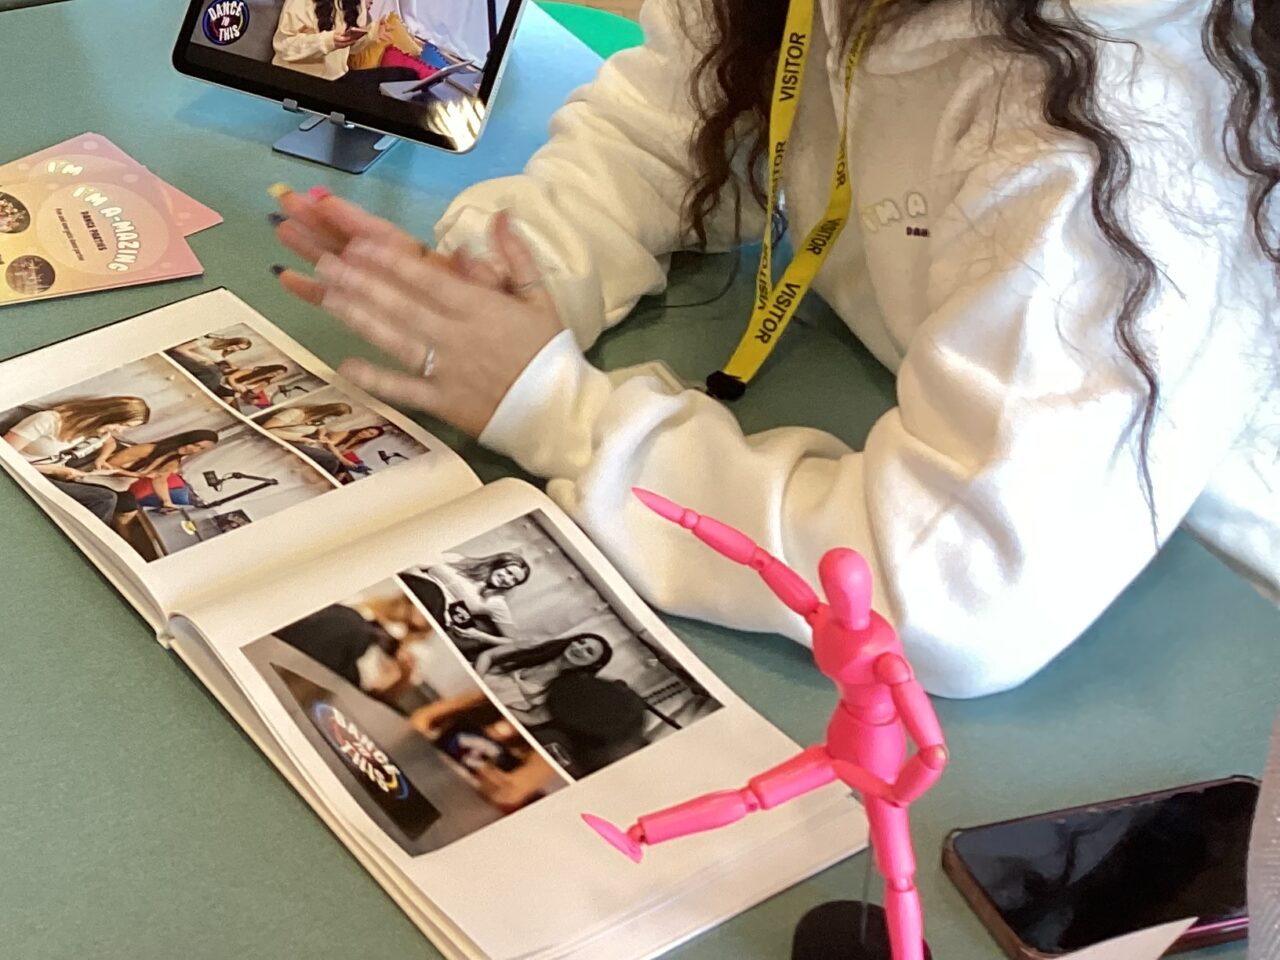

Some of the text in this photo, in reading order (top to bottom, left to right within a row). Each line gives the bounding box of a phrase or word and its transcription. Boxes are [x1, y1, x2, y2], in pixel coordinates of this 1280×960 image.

[208, 0, 245, 21] DANCE
[218, 24, 240, 41] THIS
[779, 32, 806, 102] VISITOR
[100, 206, 141, 272] A-MAZING
[755, 282, 801, 344] VISITOR
